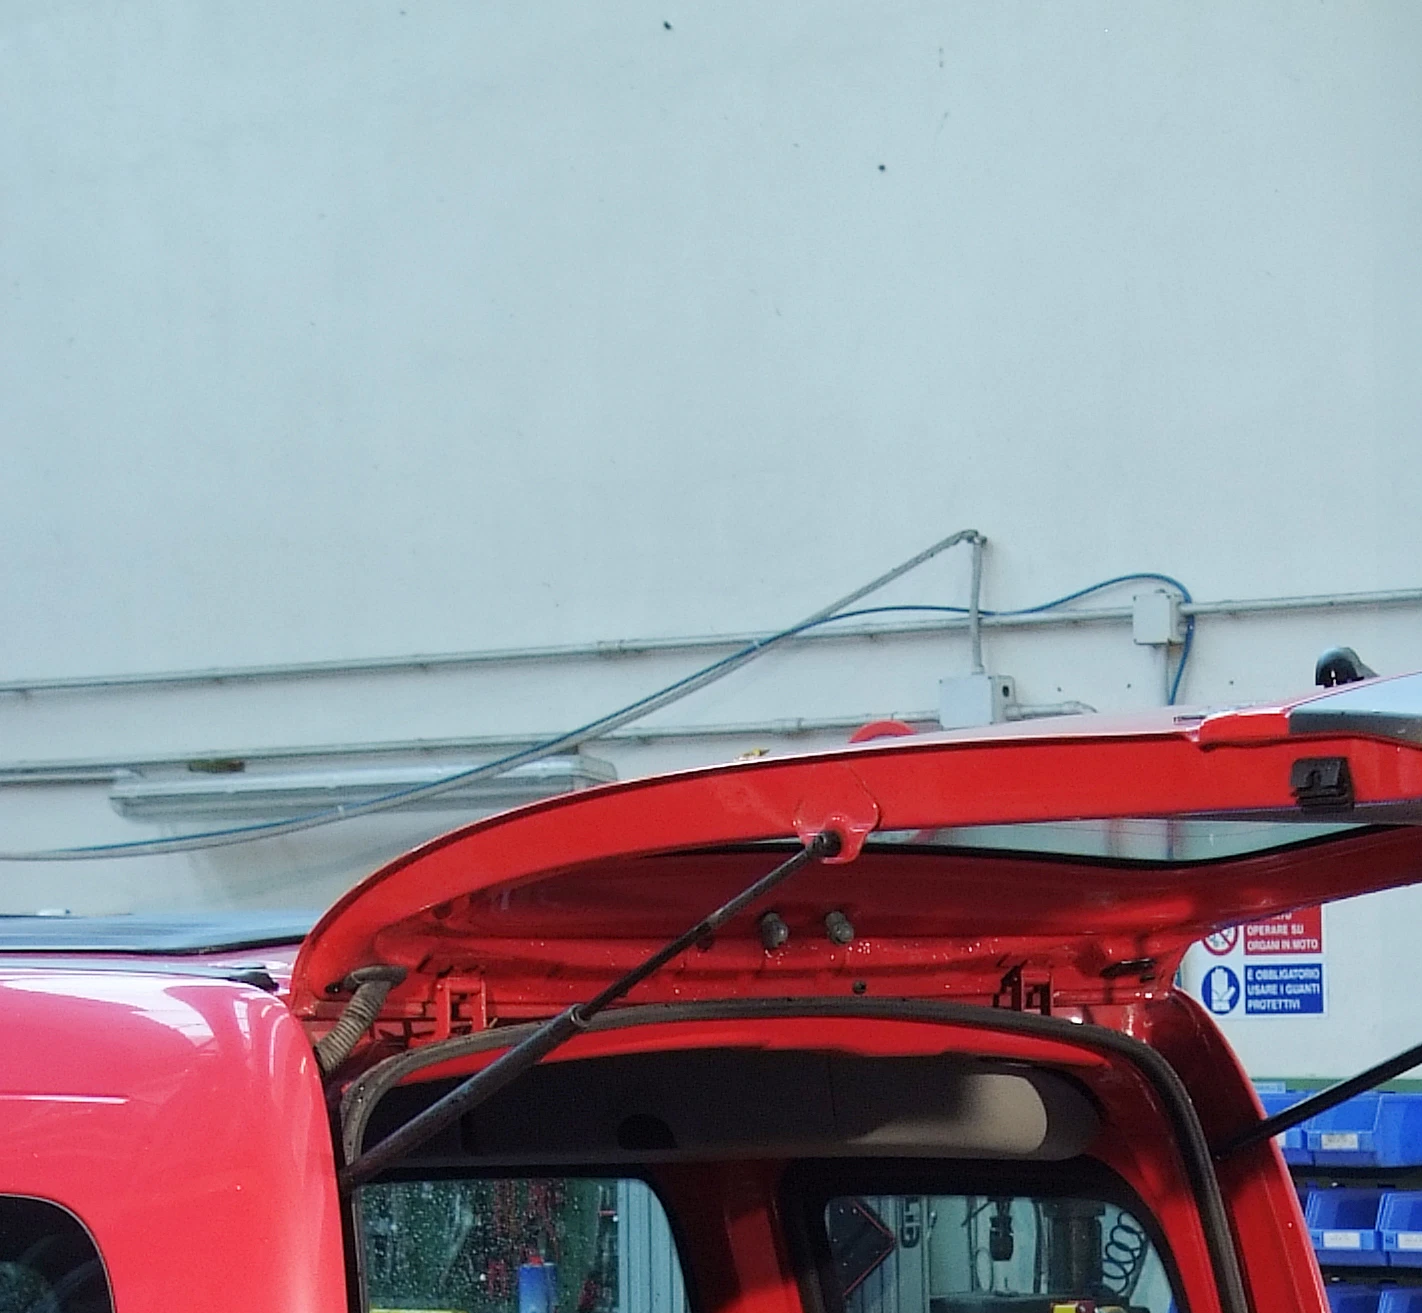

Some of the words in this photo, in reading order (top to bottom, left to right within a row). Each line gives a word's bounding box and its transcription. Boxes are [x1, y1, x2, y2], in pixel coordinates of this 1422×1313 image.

[1256, 967, 1320, 981] OBBLIGATORIO
[1247, 983, 1278, 996] USARE
[1285, 982, 1320, 995] GUANTI
[1247, 998, 1301, 1011] PROTETTIVI
